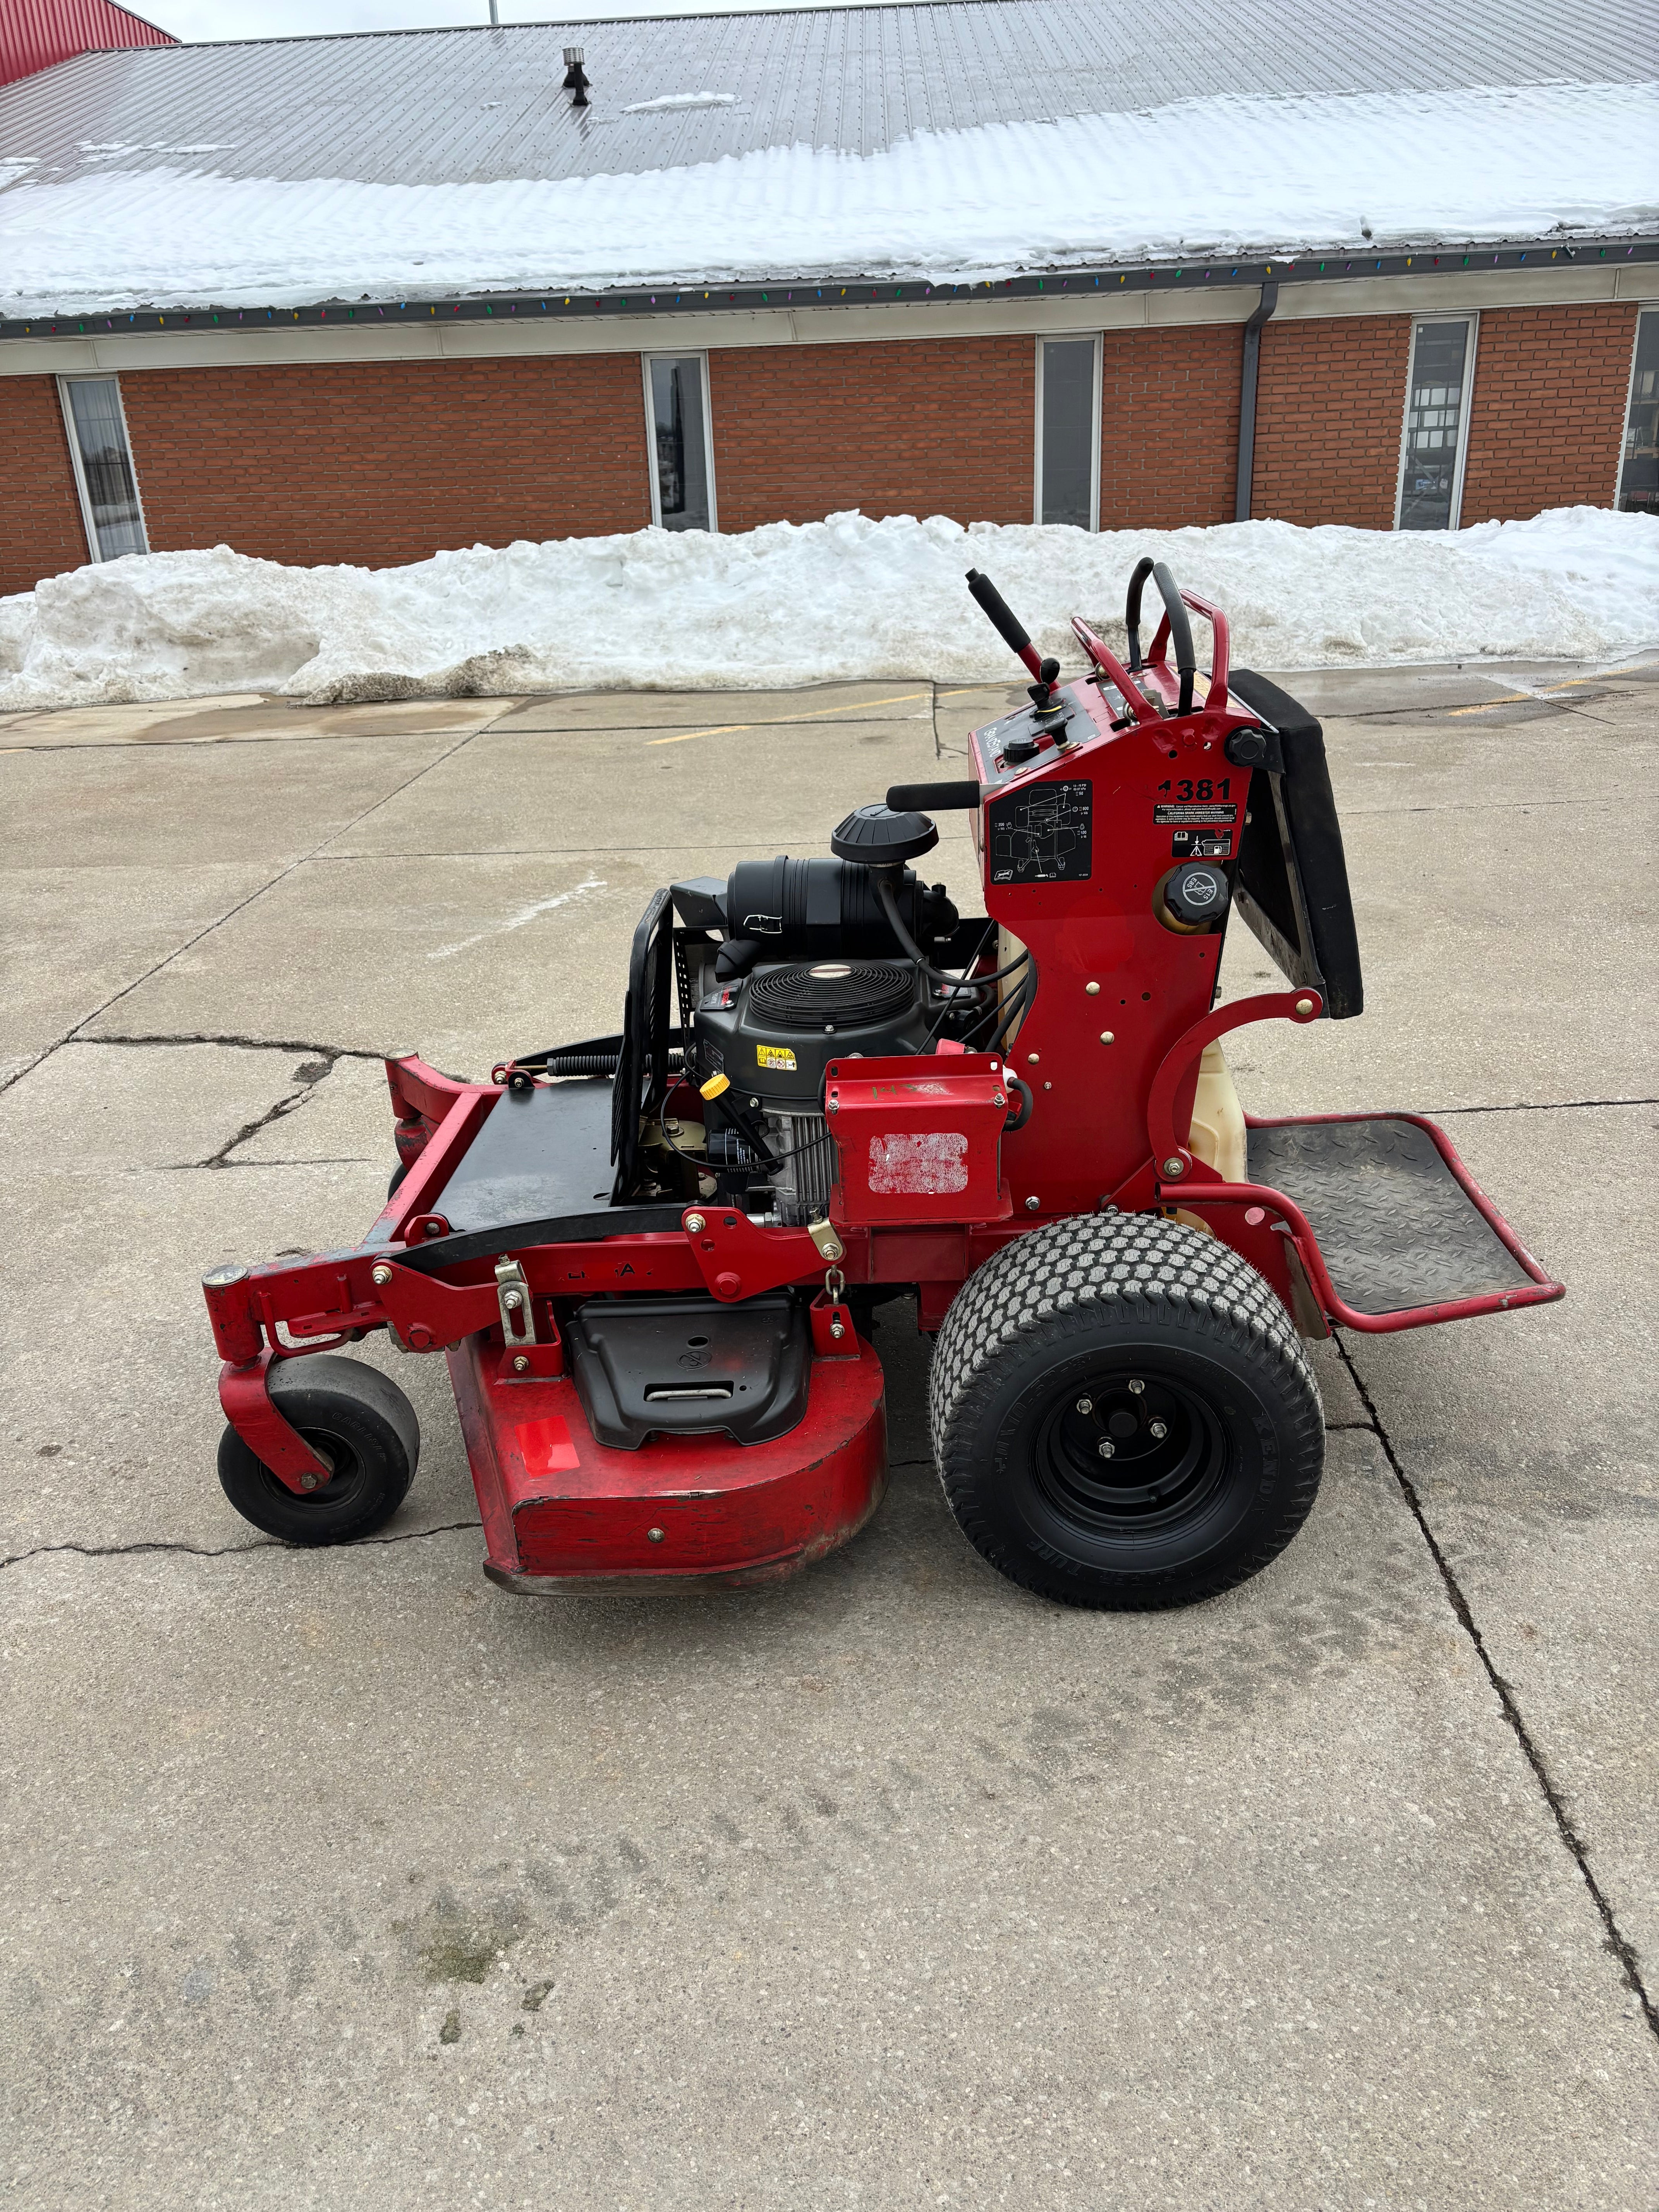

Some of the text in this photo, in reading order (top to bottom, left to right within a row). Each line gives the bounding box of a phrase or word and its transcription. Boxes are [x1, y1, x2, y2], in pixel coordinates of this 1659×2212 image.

[1187, 877, 1197, 888] E85
[1203, 889, 1213, 900] E15
[1026, 1540, 1082, 1577] TURF
